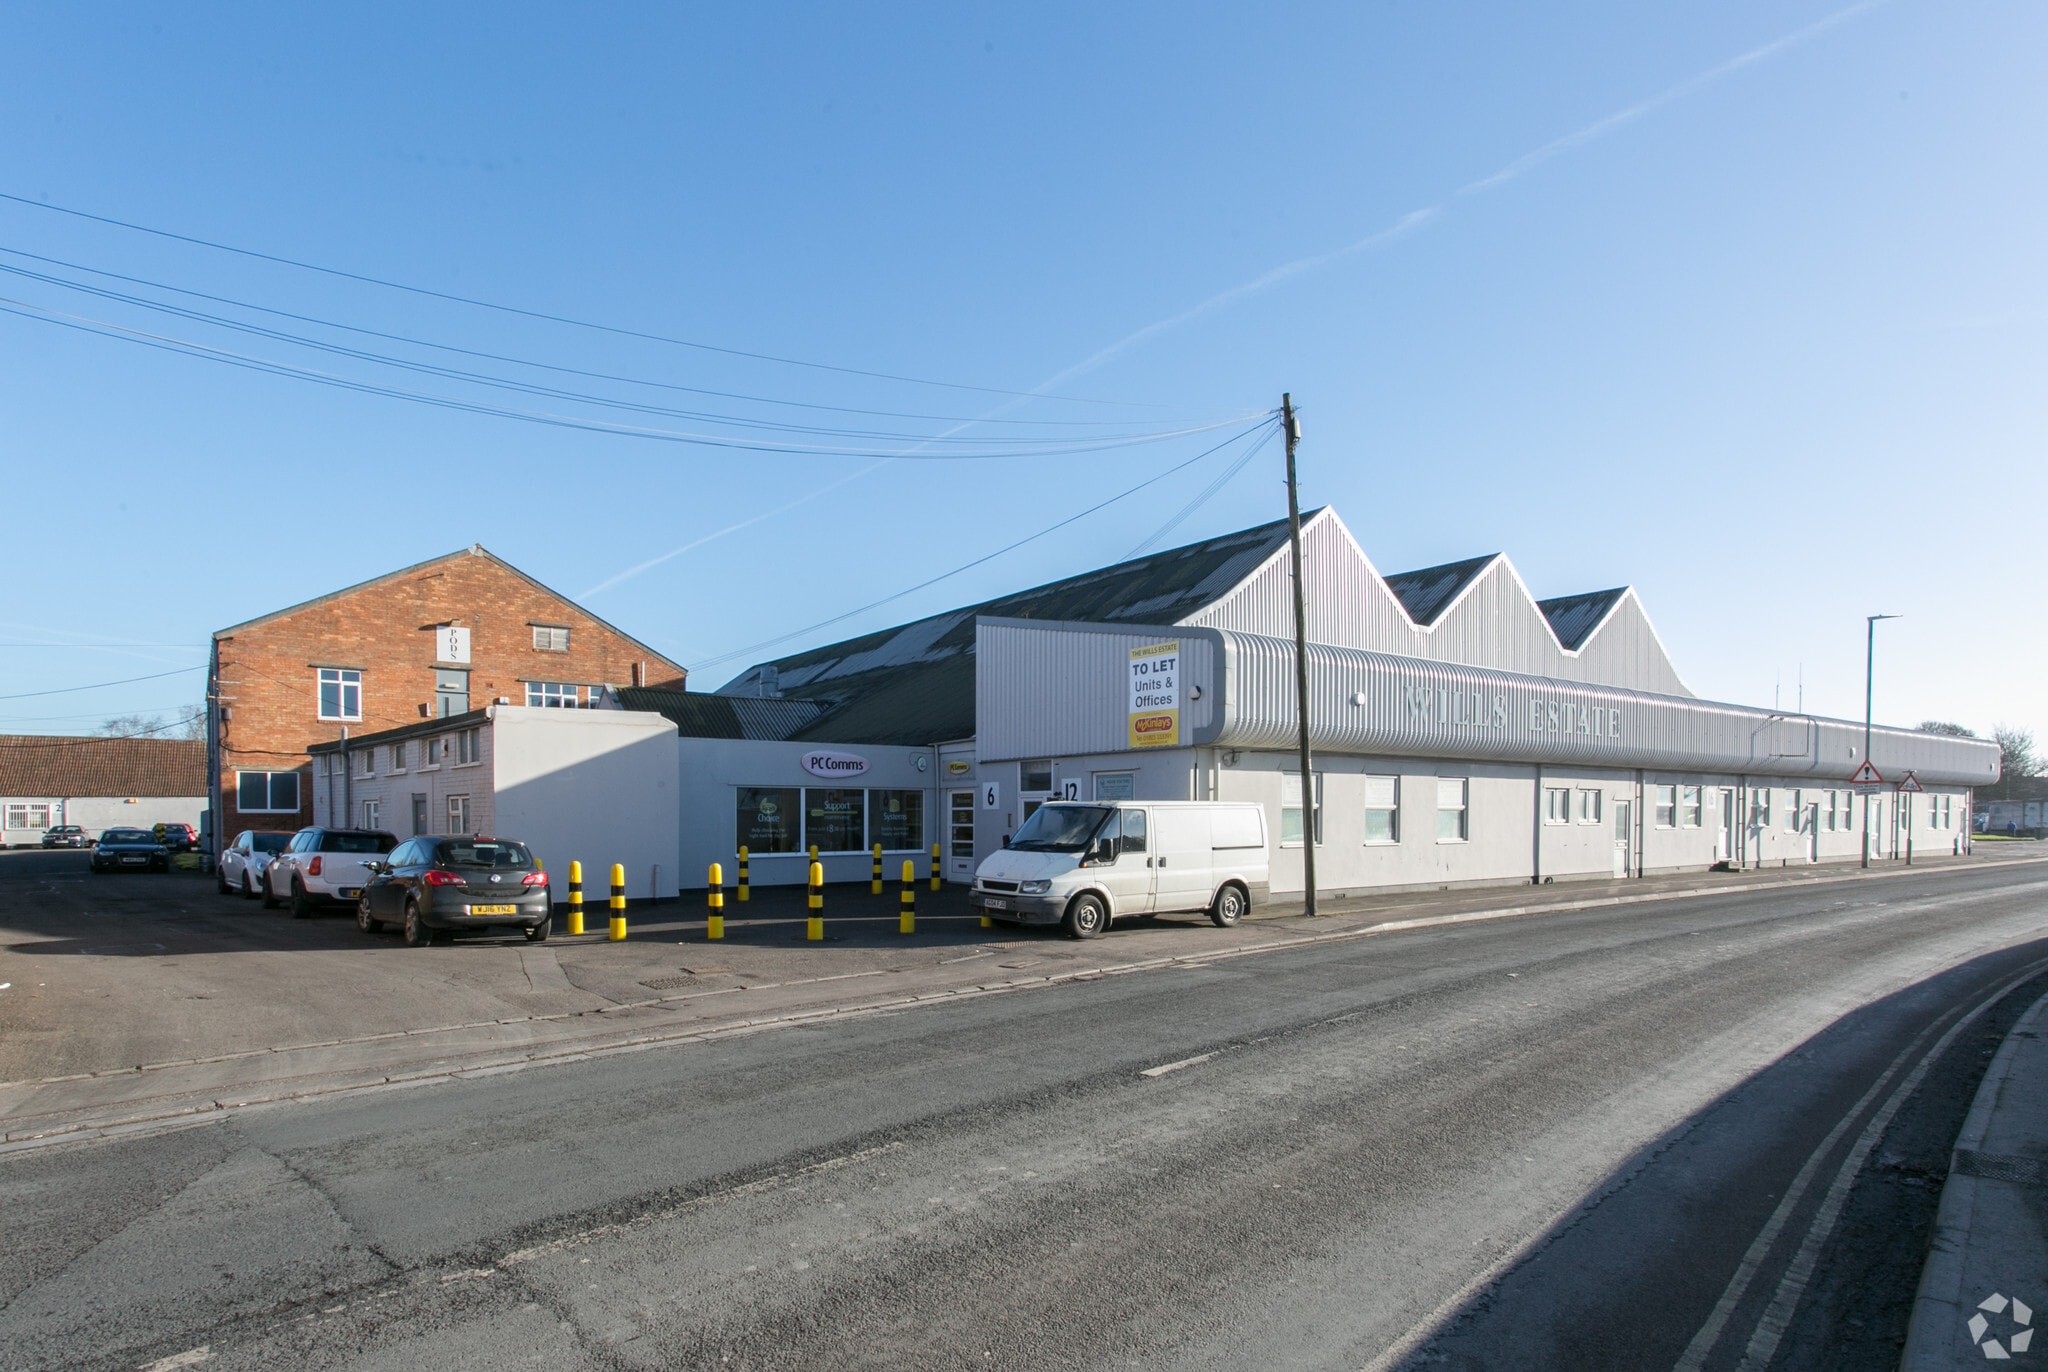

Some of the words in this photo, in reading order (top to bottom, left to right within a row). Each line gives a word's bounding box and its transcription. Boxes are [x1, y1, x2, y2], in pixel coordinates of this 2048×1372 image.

[450, 629, 458, 659] PODS
[1132, 649, 1142, 657] THE
[1142, 646, 1158, 656] WILLS
[1158, 643, 1177, 653] ESTATE
[1133, 663, 1148, 676] TO
[1152, 658, 1176, 673] LET
[1135, 679, 1162, 692] Units
[1166, 676, 1172, 688] &
[1135, 694, 1172, 708] Offices
[1403, 685, 1508, 729] WILLS
[1529, 698, 1620, 739] ESTATE
[811, 756, 824, 770] PC
[825, 757, 864, 771] Comms
[987, 786, 994, 806] 6
[1065, 782, 1077, 801] 12
[824, 800, 850, 811] Support
[757, 813, 780, 822] Choice
[883, 811, 908, 822] Systems
